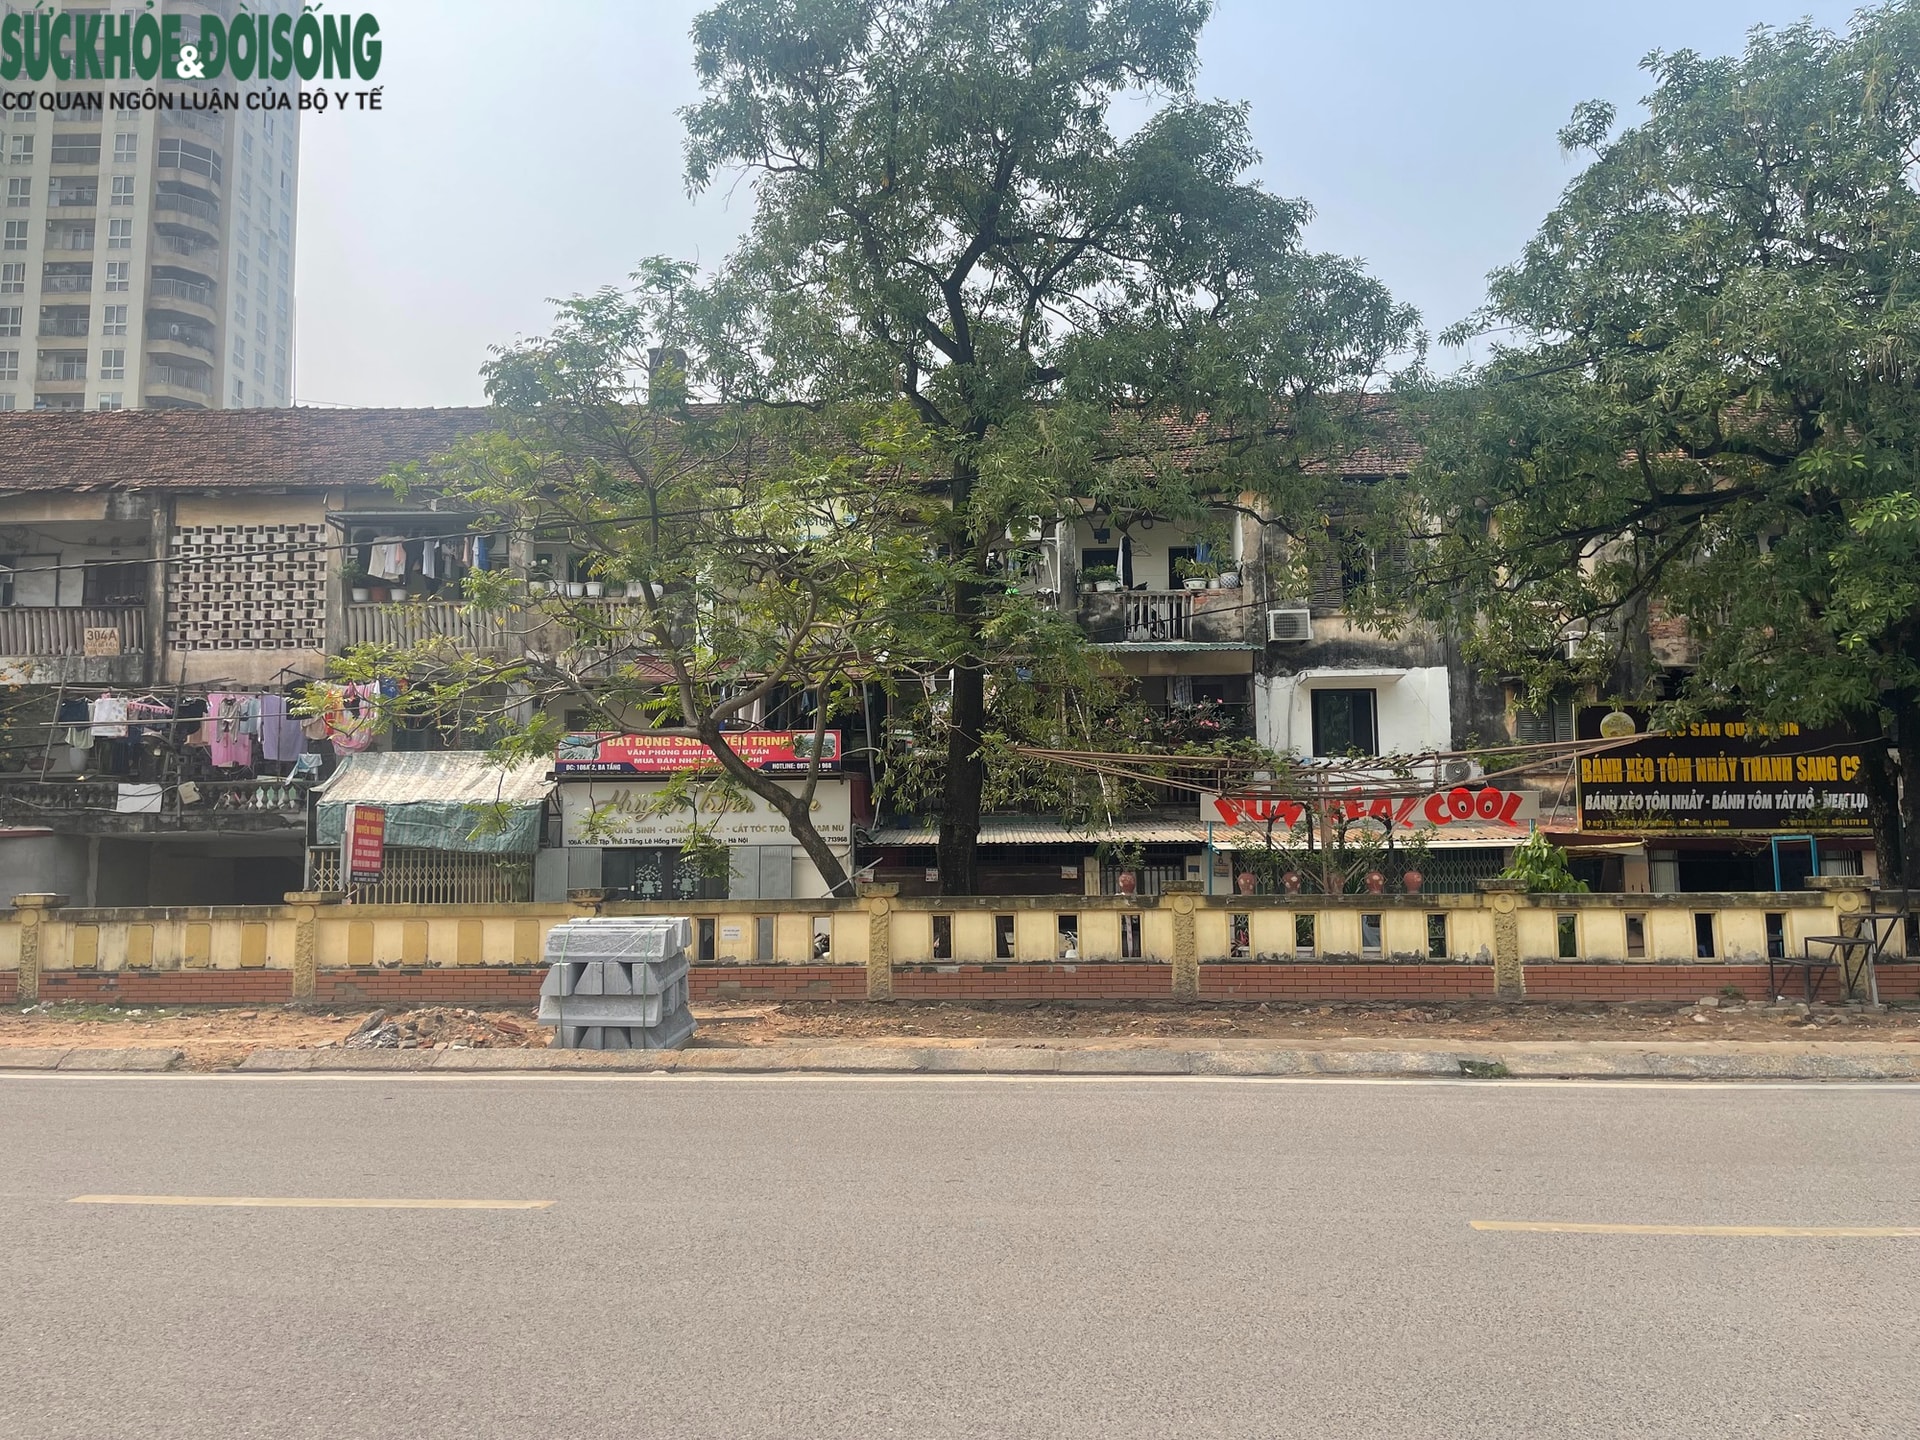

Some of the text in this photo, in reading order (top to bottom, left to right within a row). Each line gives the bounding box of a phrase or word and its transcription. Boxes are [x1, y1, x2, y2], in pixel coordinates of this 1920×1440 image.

[87, 630, 117, 641] 304A
[635, 735, 671, 748] ĐỘNG
[1581, 754, 1623, 783] BÁNH
[1625, 753, 1655, 783] XÈO
[1657, 752, 1692, 782] TÔM
[1695, 751, 1738, 782] NHẢY
[1740, 756, 1793, 782] THANH
[1796, 755, 1838, 782] SANG
[1424, 787, 1524, 828] COOL
[1584, 790, 1618, 810] BÁNH
[1619, 790, 1644, 810] XÈO
[1645, 790, 1670, 810] TÔM
[1671, 789, 1705, 810] NHẢY
[1712, 790, 1745, 810] BÁNH
[1747, 789, 1773, 809] TÔM
[1775, 789, 1797, 809] TÂY
[1796, 787, 1815, 809] HỒ
